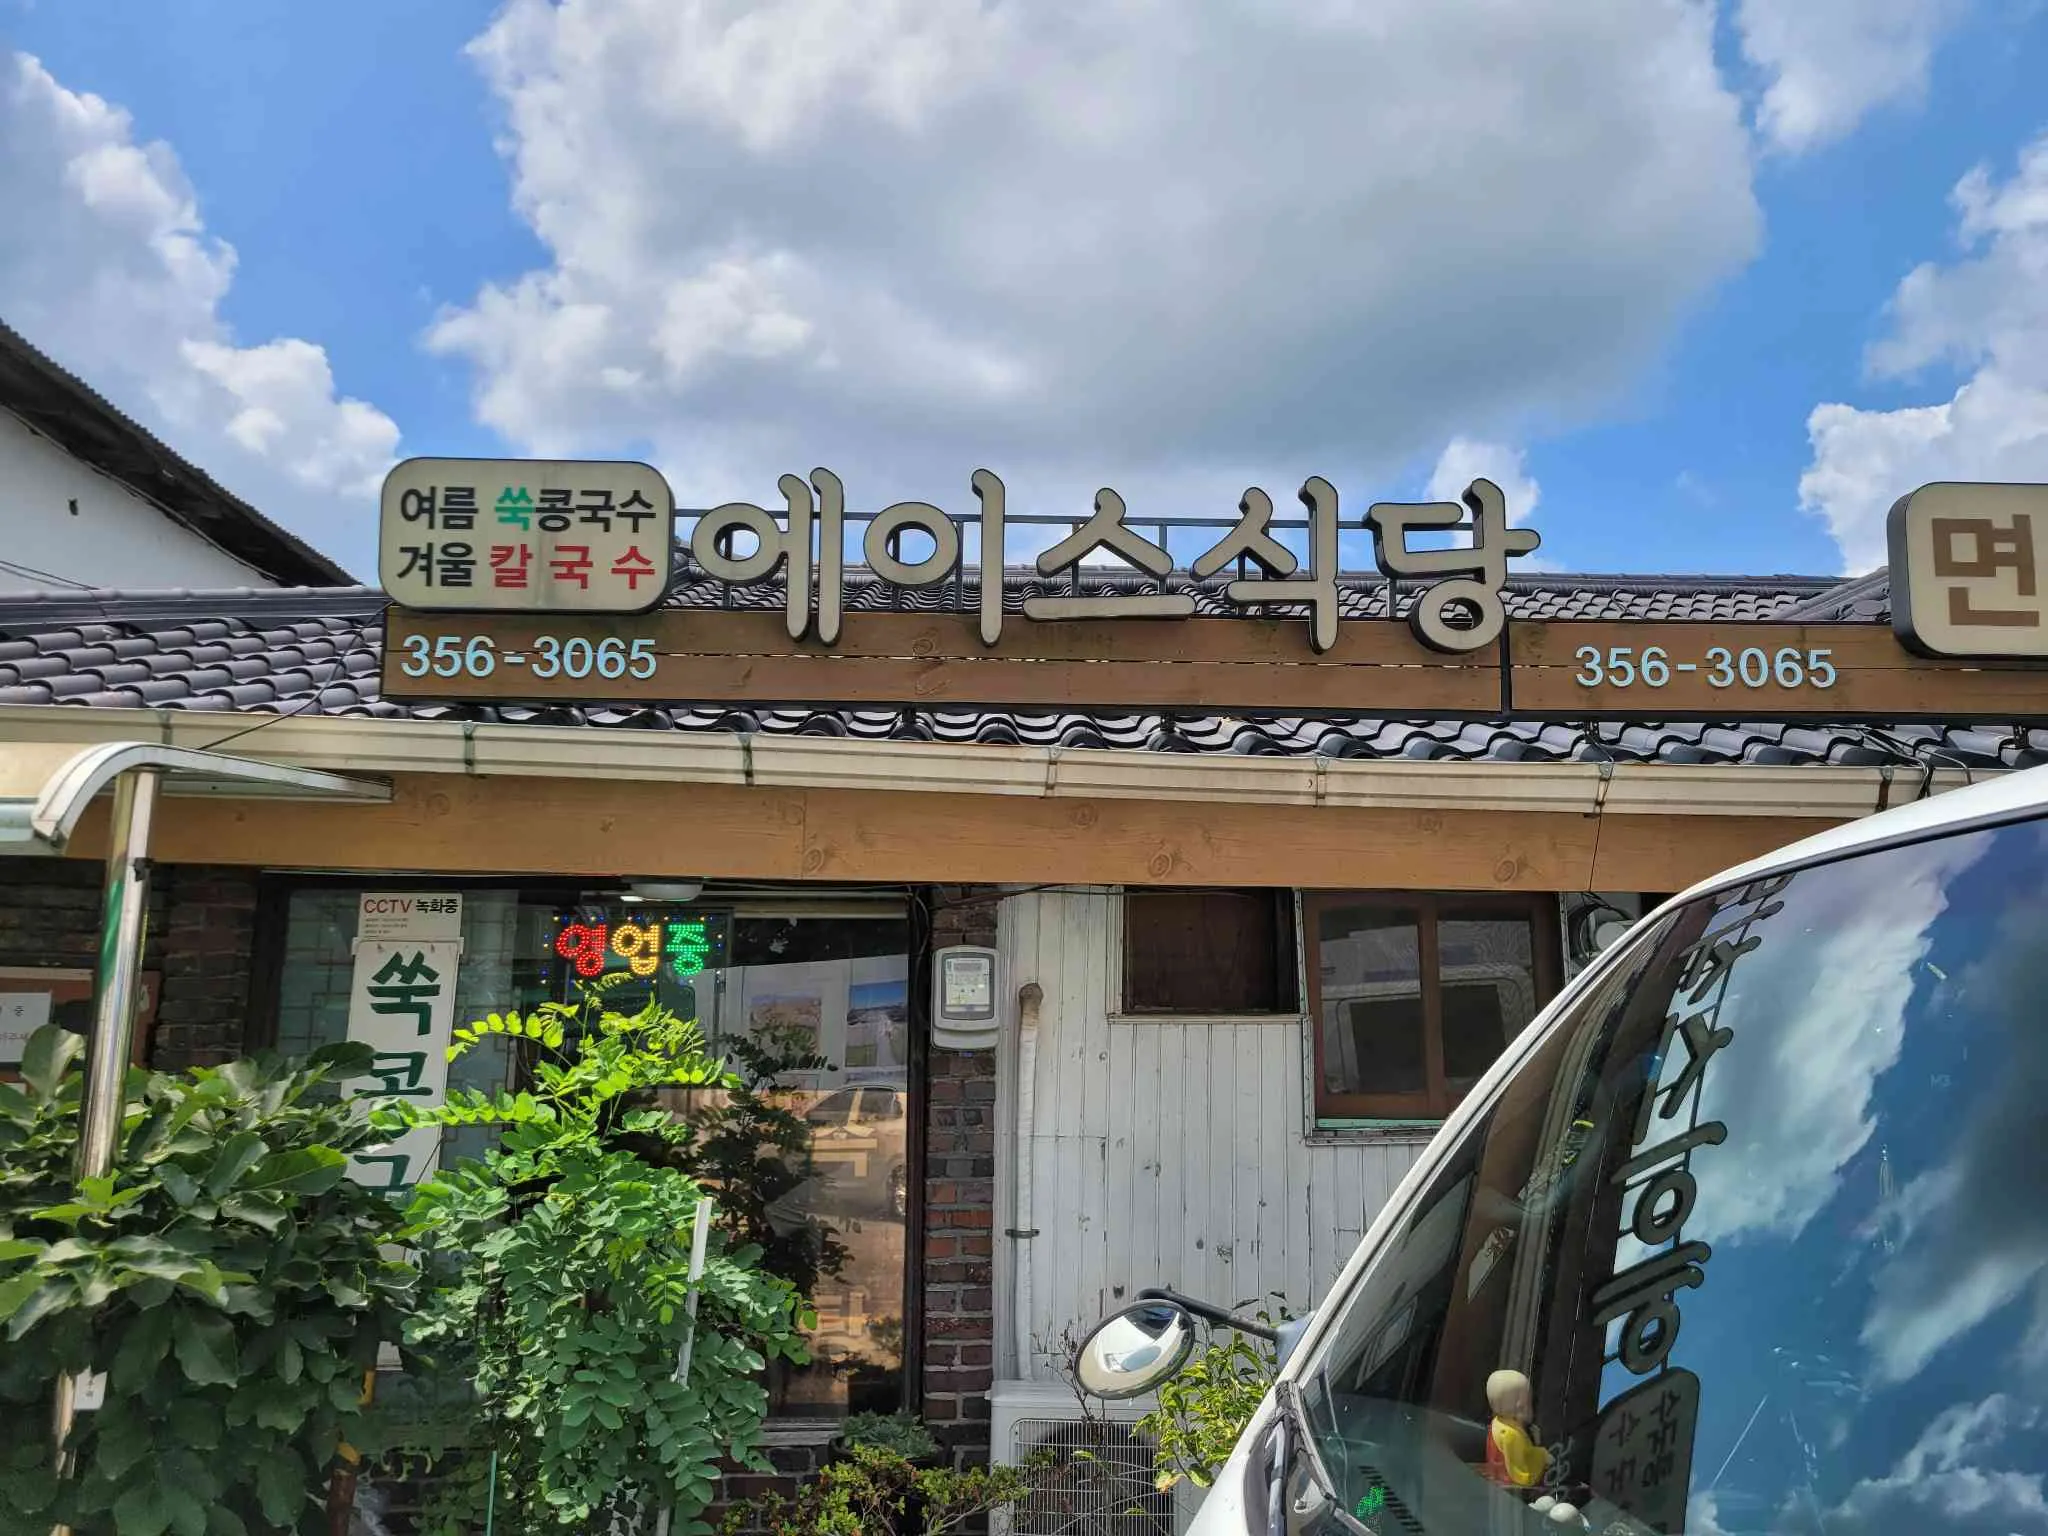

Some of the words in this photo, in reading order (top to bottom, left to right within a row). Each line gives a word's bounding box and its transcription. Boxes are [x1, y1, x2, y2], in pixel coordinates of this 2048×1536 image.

[400, 485, 479, 531] 여름
[494, 486, 657, 534] 쑥콩국수
[396, 542, 477, 588] 겨울
[691, 467, 1541, 654] 에이스식당
[400, 634, 657, 680] 356-3065
[1574, 646, 1838, 689] 356-3065
[364, 899, 412, 914] CCTV
[416, 898, 458, 914] 녹화중
[554, 923, 709, 977] 영업중
